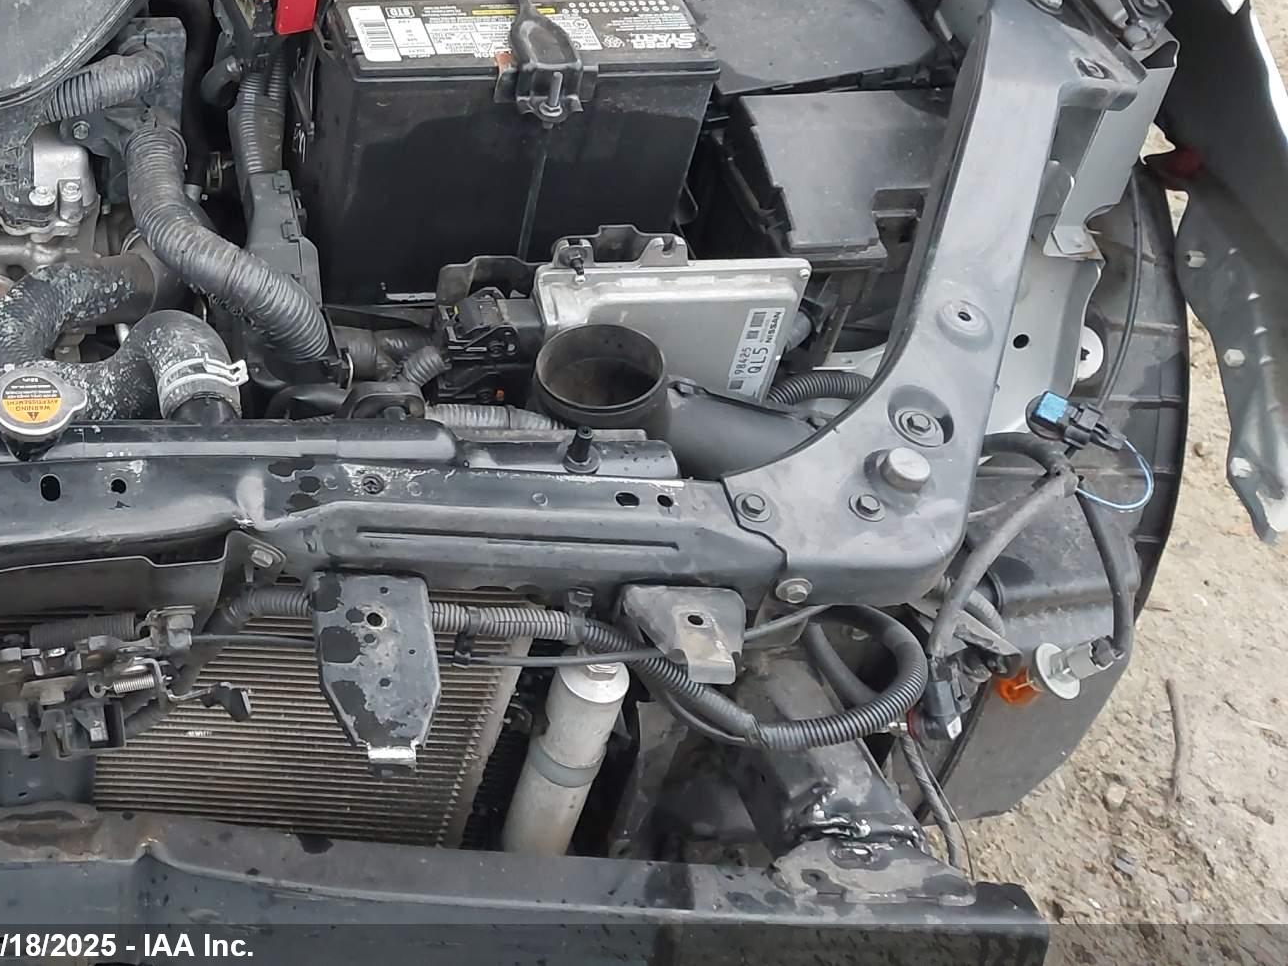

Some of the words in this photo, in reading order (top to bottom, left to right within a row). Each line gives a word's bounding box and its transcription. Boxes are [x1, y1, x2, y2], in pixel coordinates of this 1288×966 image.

[765, 311, 781, 343] NISSAN
[734, 347, 752, 375] 98425
[748, 347, 768, 374] QL5
